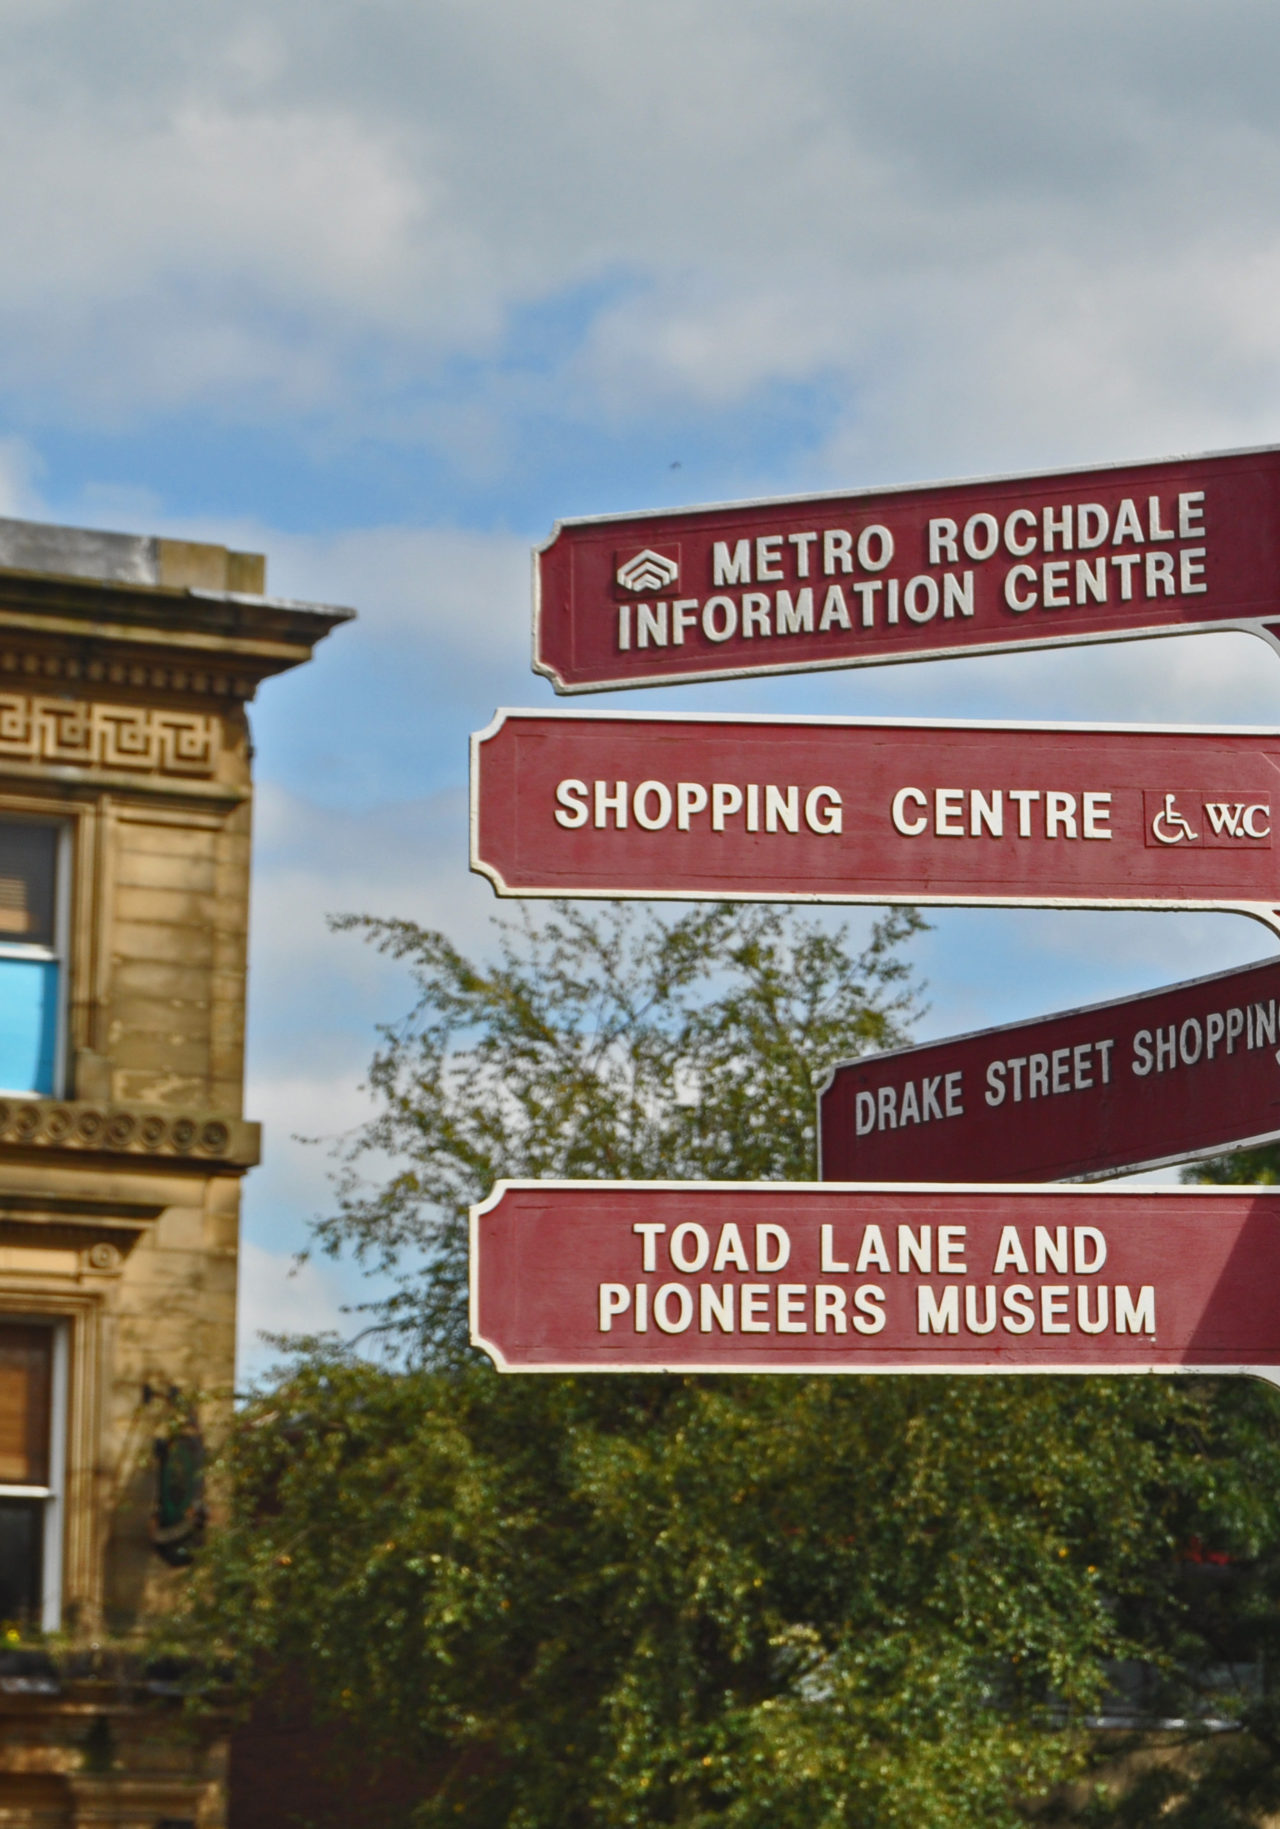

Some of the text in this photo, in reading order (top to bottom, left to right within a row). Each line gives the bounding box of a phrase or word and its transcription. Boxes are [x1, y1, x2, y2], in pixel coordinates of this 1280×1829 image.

[714, 491, 1205, 585] METRO ROCHDALE
[620, 548, 1206, 649] INFORMATION CENTRE
[555, 779, 1112, 838] SHOPPING CENTRE
[856, 1072, 963, 1135] DRAKE
[985, 1040, 1113, 1106] STREET
[634, 1222, 1106, 1273] TOAD LANE AND
[600, 1283, 1155, 1333] PIONEERS MUSEUM
